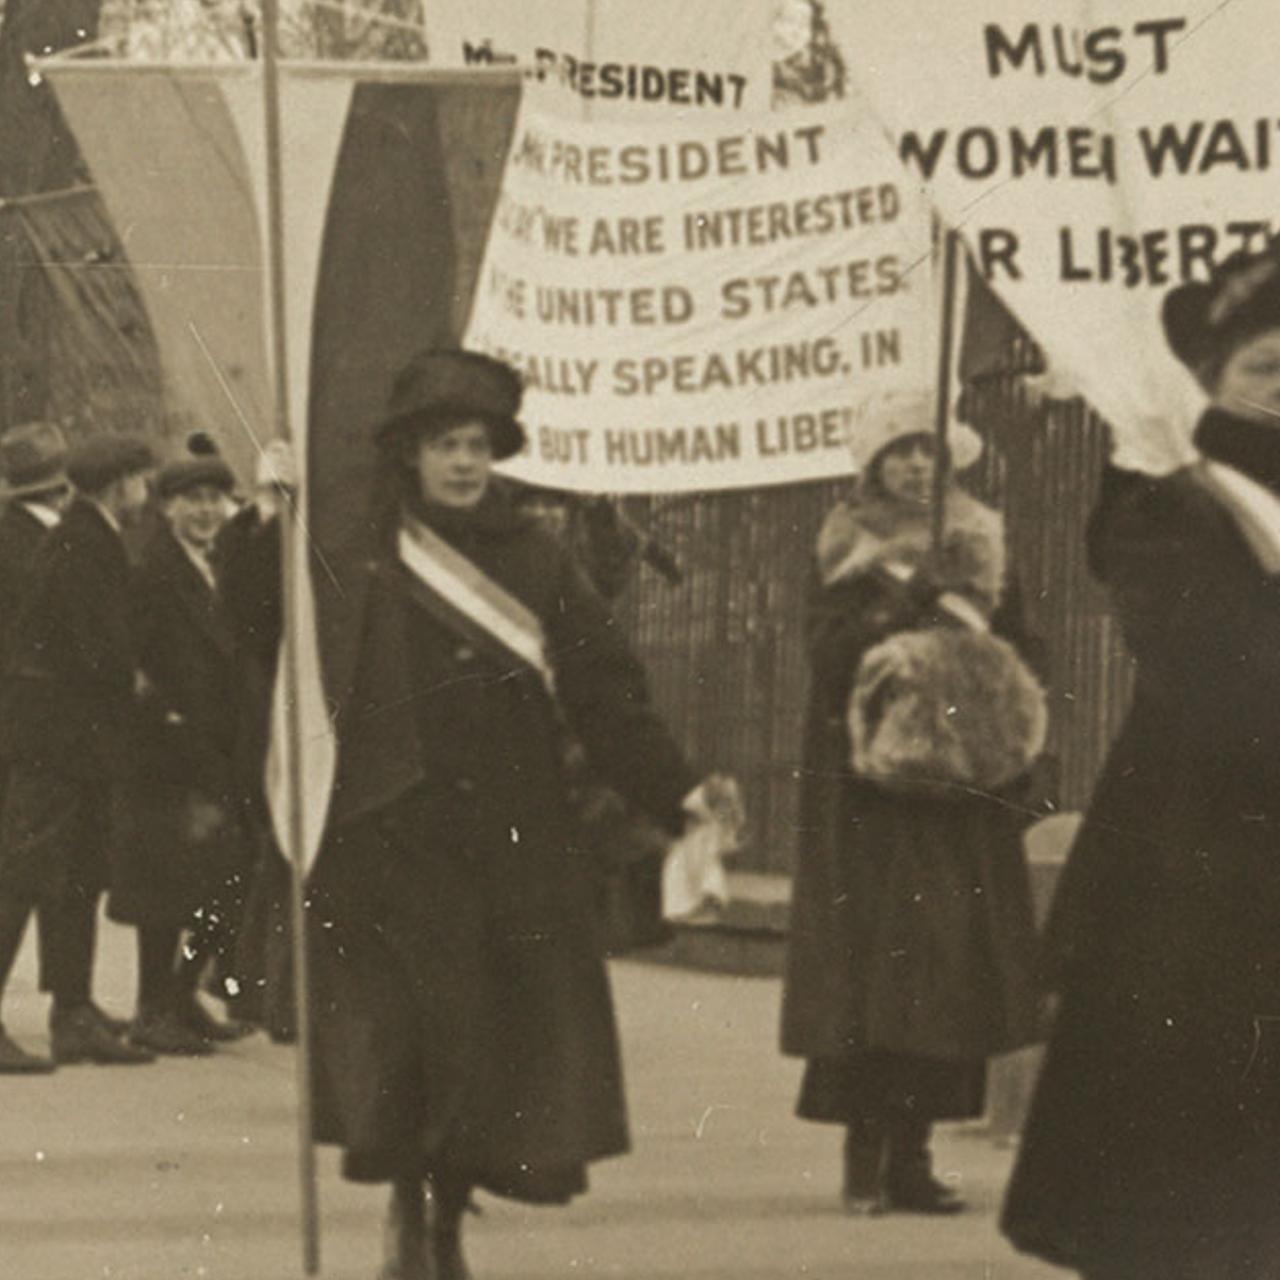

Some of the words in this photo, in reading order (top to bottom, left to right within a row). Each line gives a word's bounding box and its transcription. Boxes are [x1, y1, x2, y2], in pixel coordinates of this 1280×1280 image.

[983, 17, 1187, 85] MUST
[588, 214, 667, 257] ARE
[683, 182, 902, 253] INTERESTED
[535, 284, 696, 326] UNITED
[860, 327, 902, 369] IN
[538, 424, 591, 465] BUT
[604, 422, 742, 466] HUMAN
